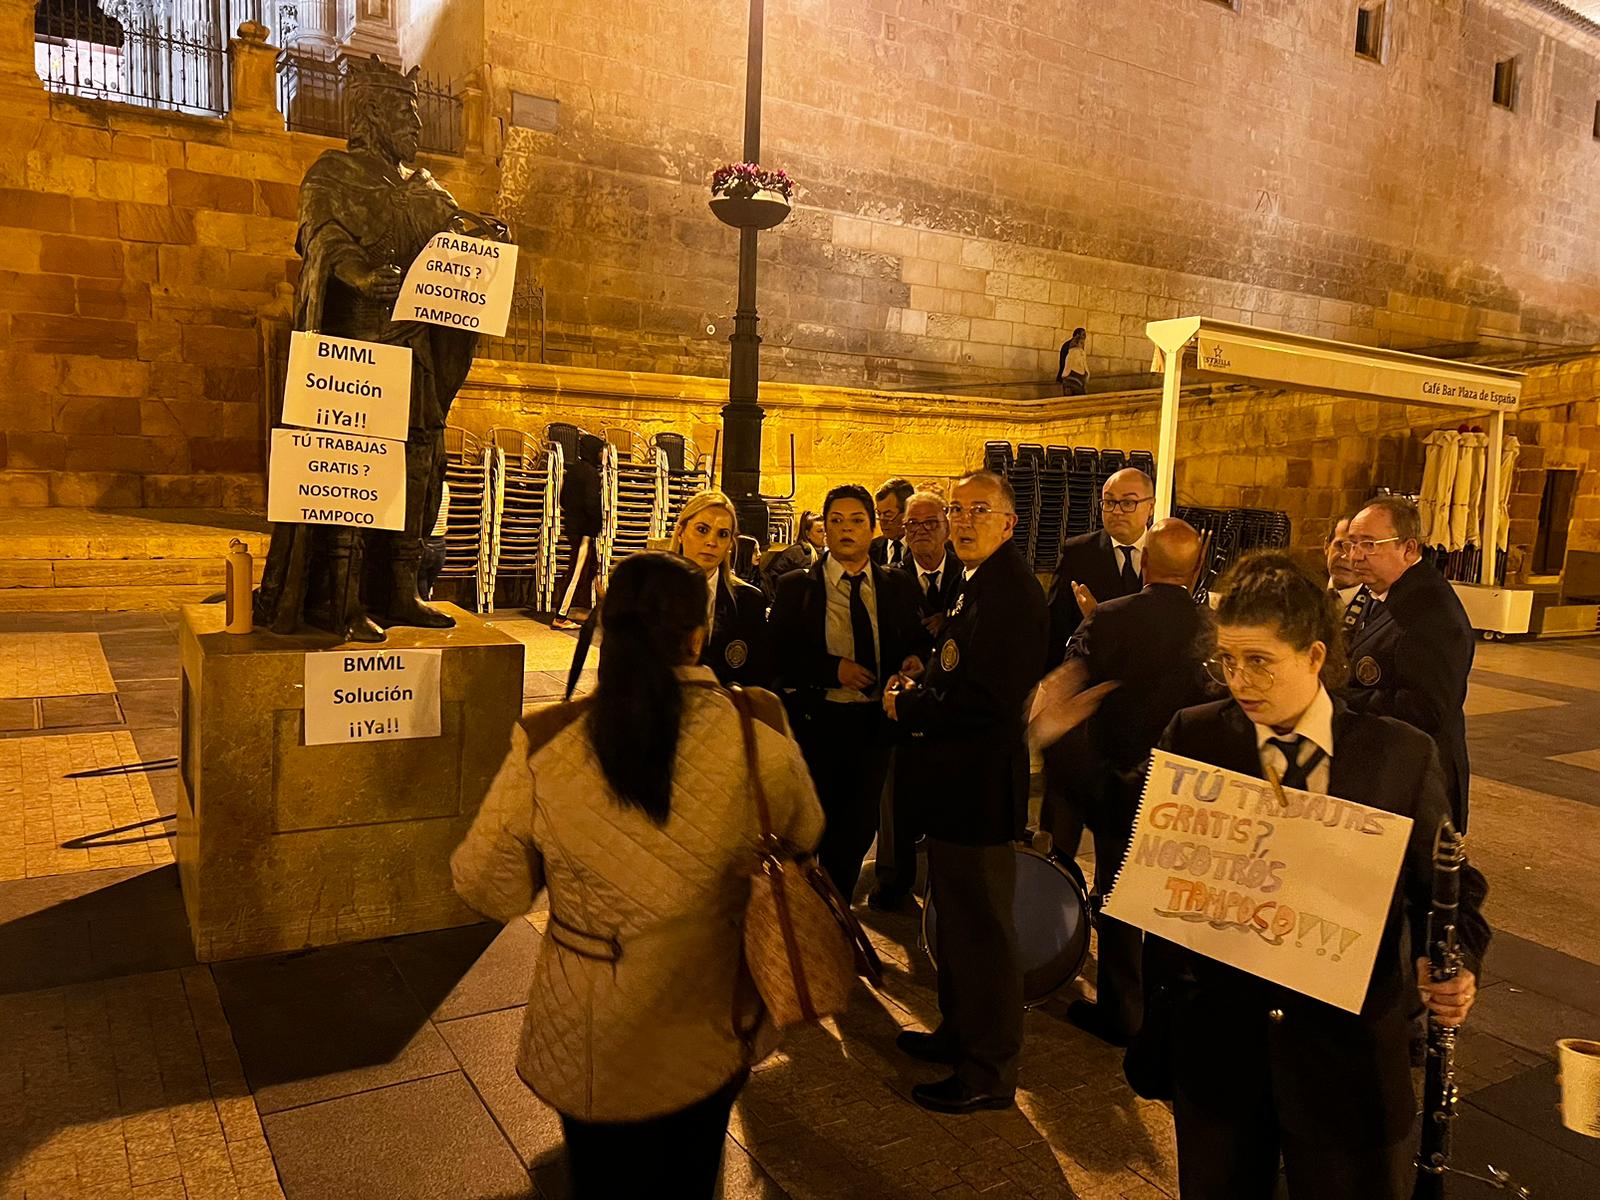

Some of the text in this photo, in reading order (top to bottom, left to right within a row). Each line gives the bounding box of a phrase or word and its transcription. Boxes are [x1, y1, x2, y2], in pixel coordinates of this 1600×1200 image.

[436, 237, 500, 258] TRABAJAS
[426, 260, 482, 279] GRATIS ?
[415, 283, 487, 305] NOSOTROS
[413, 306, 480, 328] TAMPOCO
[318, 342, 376, 365] BMML
[305, 372, 382, 399] Solución
[1422, 381, 1517, 405] Café Bar Plaza de España
[316, 408, 367, 429] ¡¡Ya!!
[292, 433, 388, 455] TÚ TRABAJAS
[308, 460, 371, 477] GRATIS ?
[298, 484, 378, 501] NOSOTROS
[301, 508, 374, 525] TAMPOCO
[343, 655, 405, 672] BMML
[333, 685, 413, 704] Solución
[349, 717, 399, 737] ¡¡Ya!!
[1164, 761, 1224, 803] TÚ
